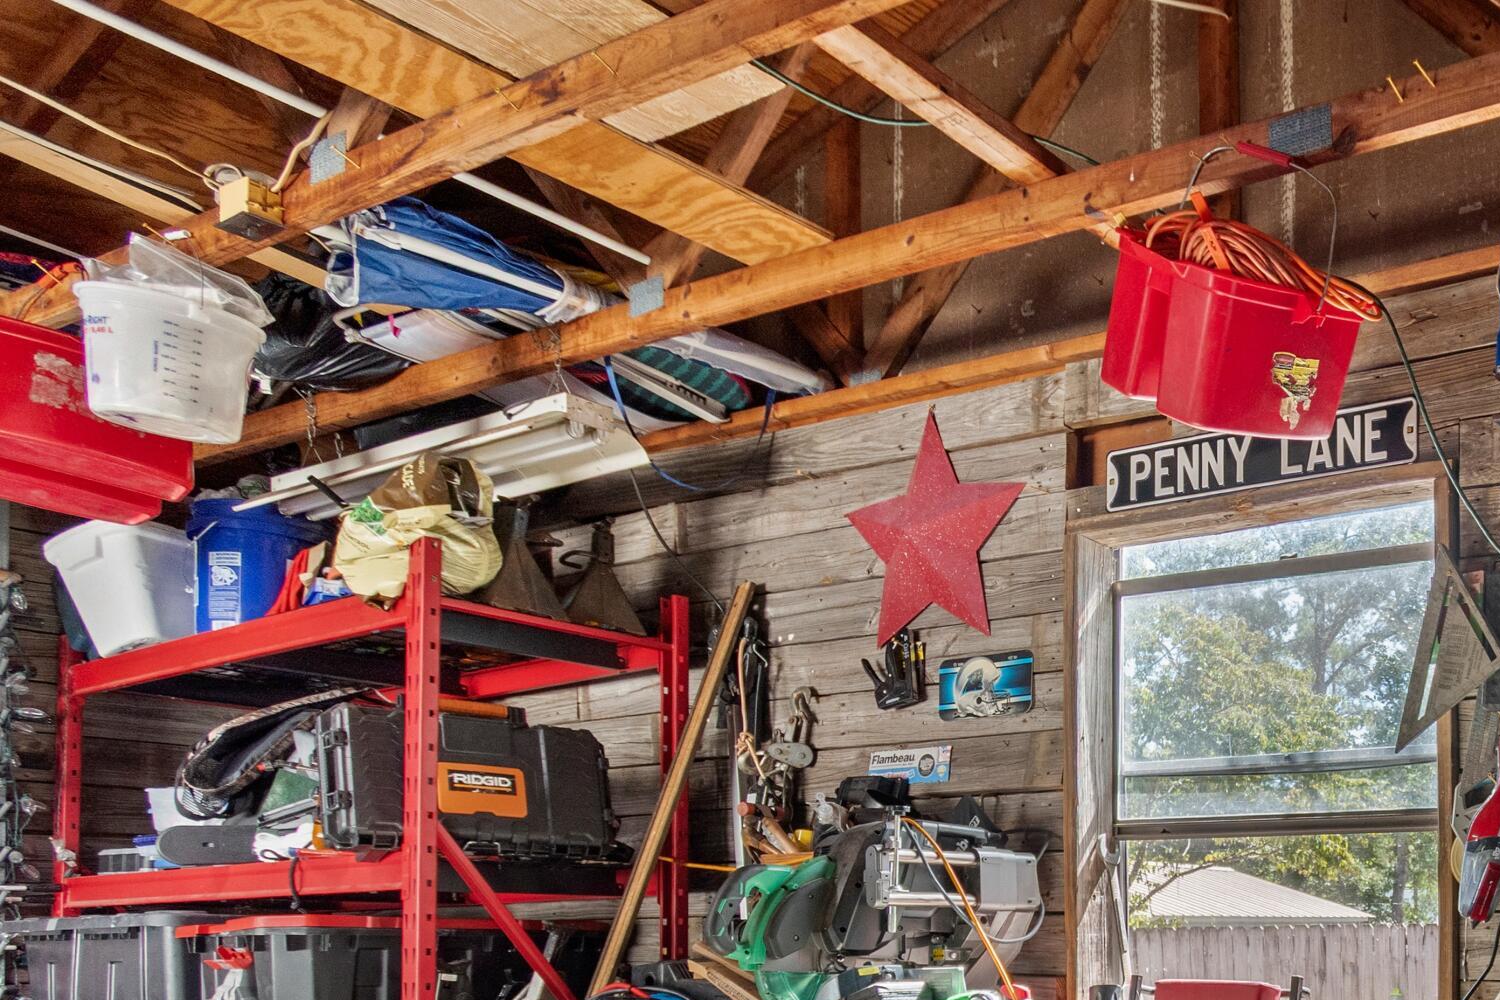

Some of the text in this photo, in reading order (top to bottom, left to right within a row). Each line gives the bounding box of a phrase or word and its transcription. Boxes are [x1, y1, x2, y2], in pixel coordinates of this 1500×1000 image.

[1129, 409, 1388, 502] PENNY LANE
[871, 753, 916, 766] Flambeau
[452, 773, 513, 787] RIDGID
